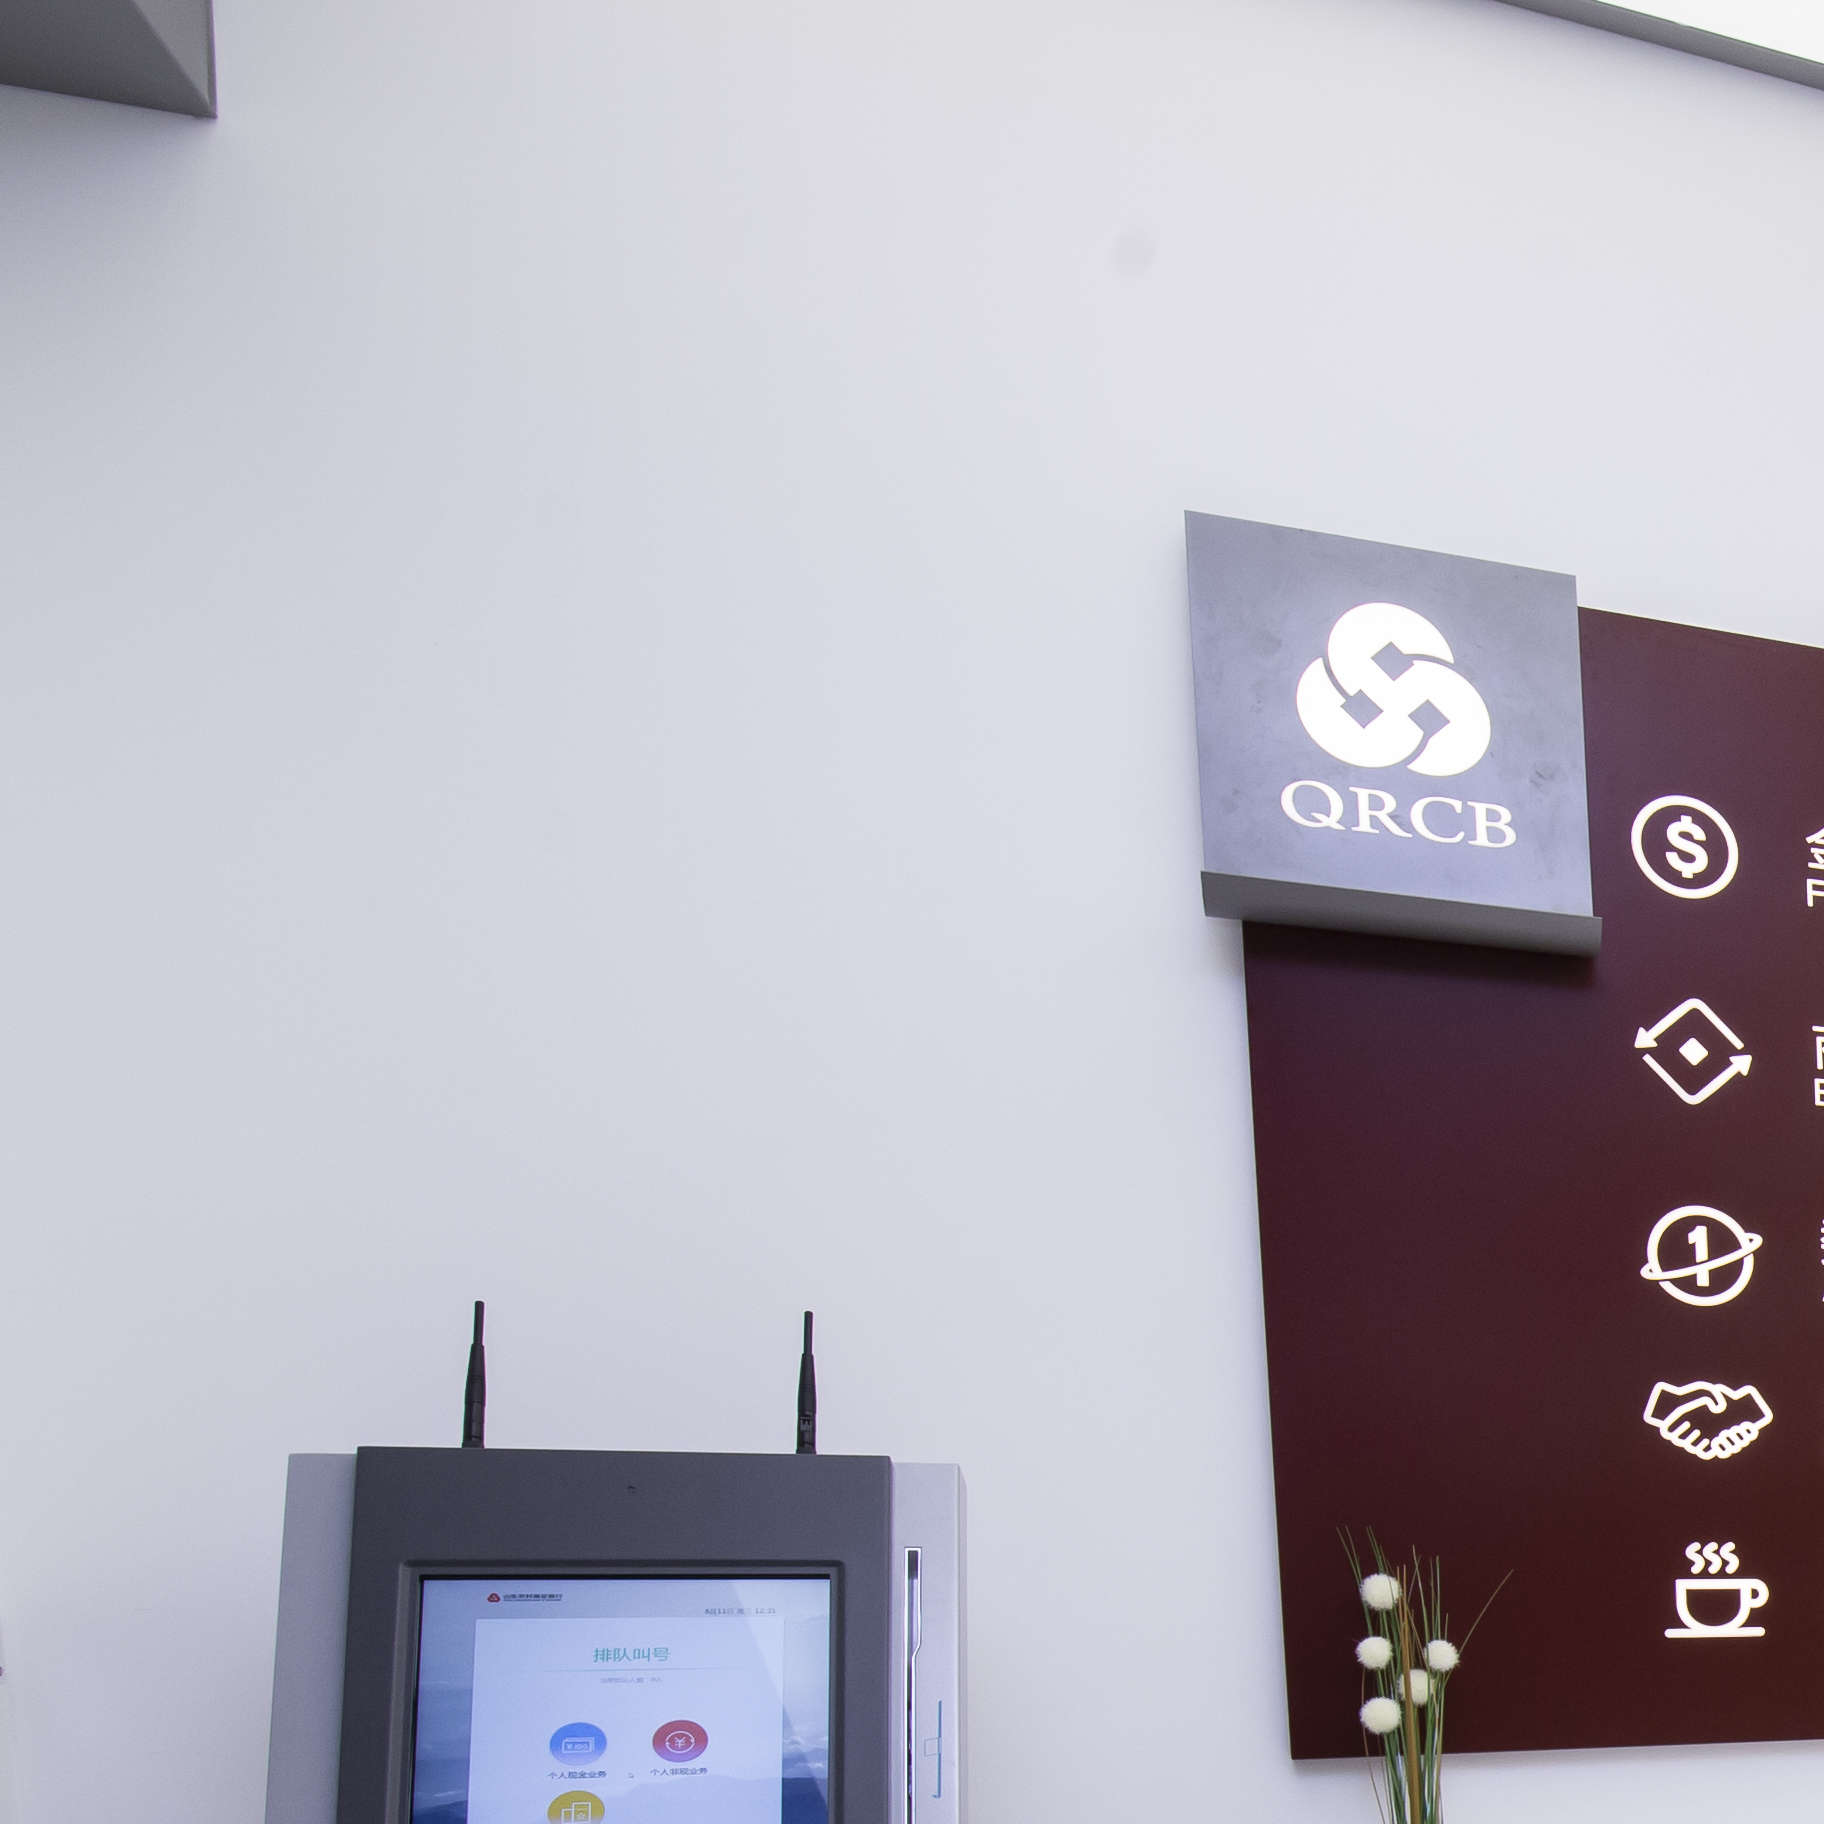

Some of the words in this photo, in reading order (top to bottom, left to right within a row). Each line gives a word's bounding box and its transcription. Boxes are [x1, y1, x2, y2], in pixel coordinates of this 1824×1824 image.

[1281, 780, 1517, 848] QRCB
[593, 1647, 671, 1663] 排队叫号
